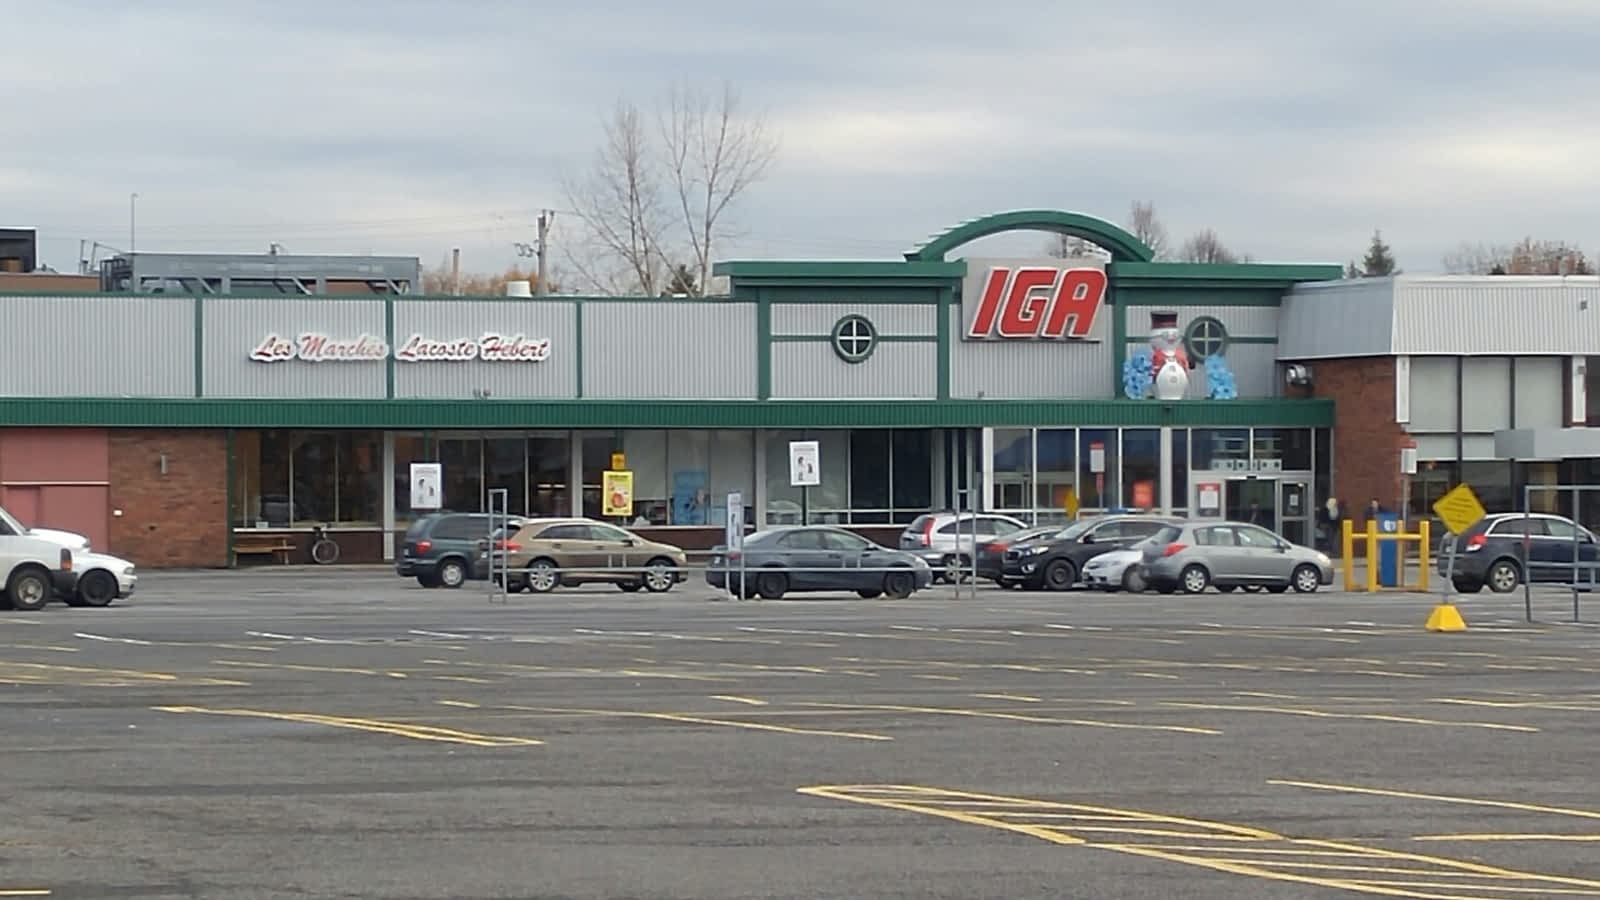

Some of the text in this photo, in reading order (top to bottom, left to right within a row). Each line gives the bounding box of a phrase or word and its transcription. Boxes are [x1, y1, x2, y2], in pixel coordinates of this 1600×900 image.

[968, 267, 1108, 338] IGA
[253, 334, 293, 359] Les
[398, 334, 475, 359] Lacoste
